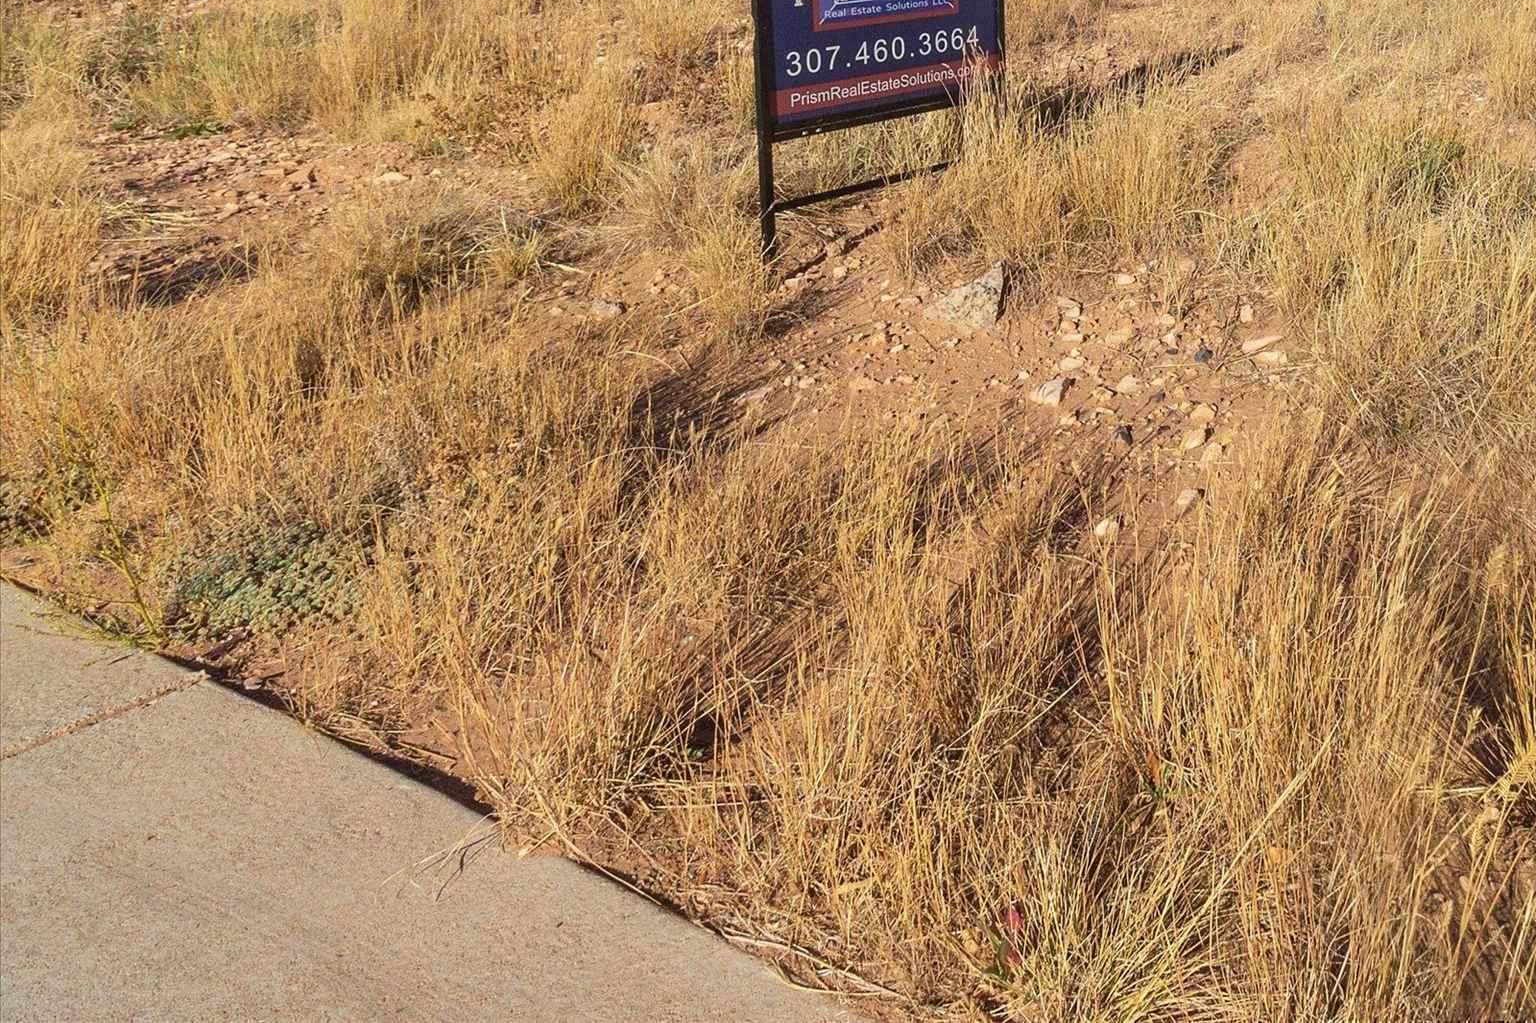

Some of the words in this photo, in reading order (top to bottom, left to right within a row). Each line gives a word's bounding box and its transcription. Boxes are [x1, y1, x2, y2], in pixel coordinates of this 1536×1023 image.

[824, 8, 847, 19] Real
[850, 4, 882, 17] Estate
[786, 25, 979, 77] 307.460.3664
[790, 64, 980, 108] PrismRealEstateSolutions.co
